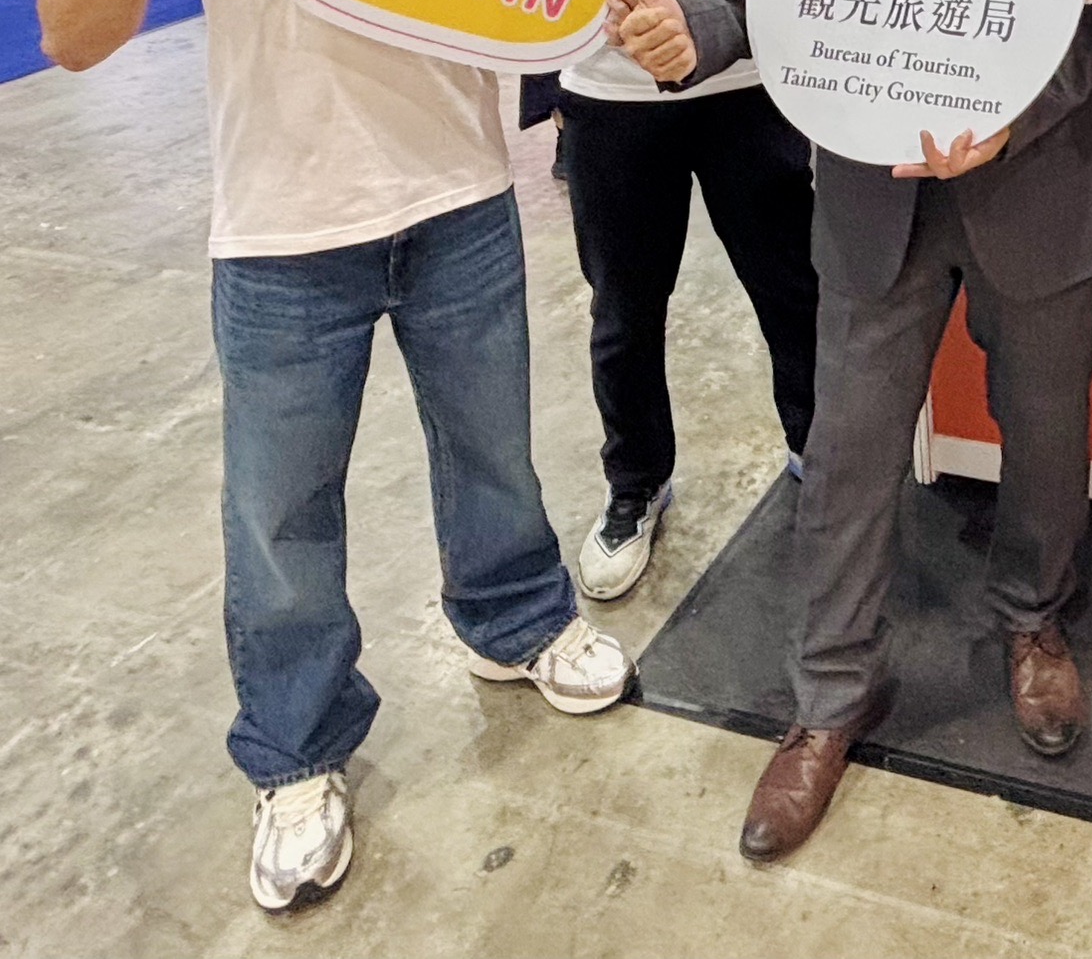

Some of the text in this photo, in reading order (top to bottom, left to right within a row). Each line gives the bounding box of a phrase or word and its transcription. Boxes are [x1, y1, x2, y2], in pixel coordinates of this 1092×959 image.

[810, 40, 981, 82] Bureau of Tourism,
[780, 65, 1003, 115] Tainan City Government
